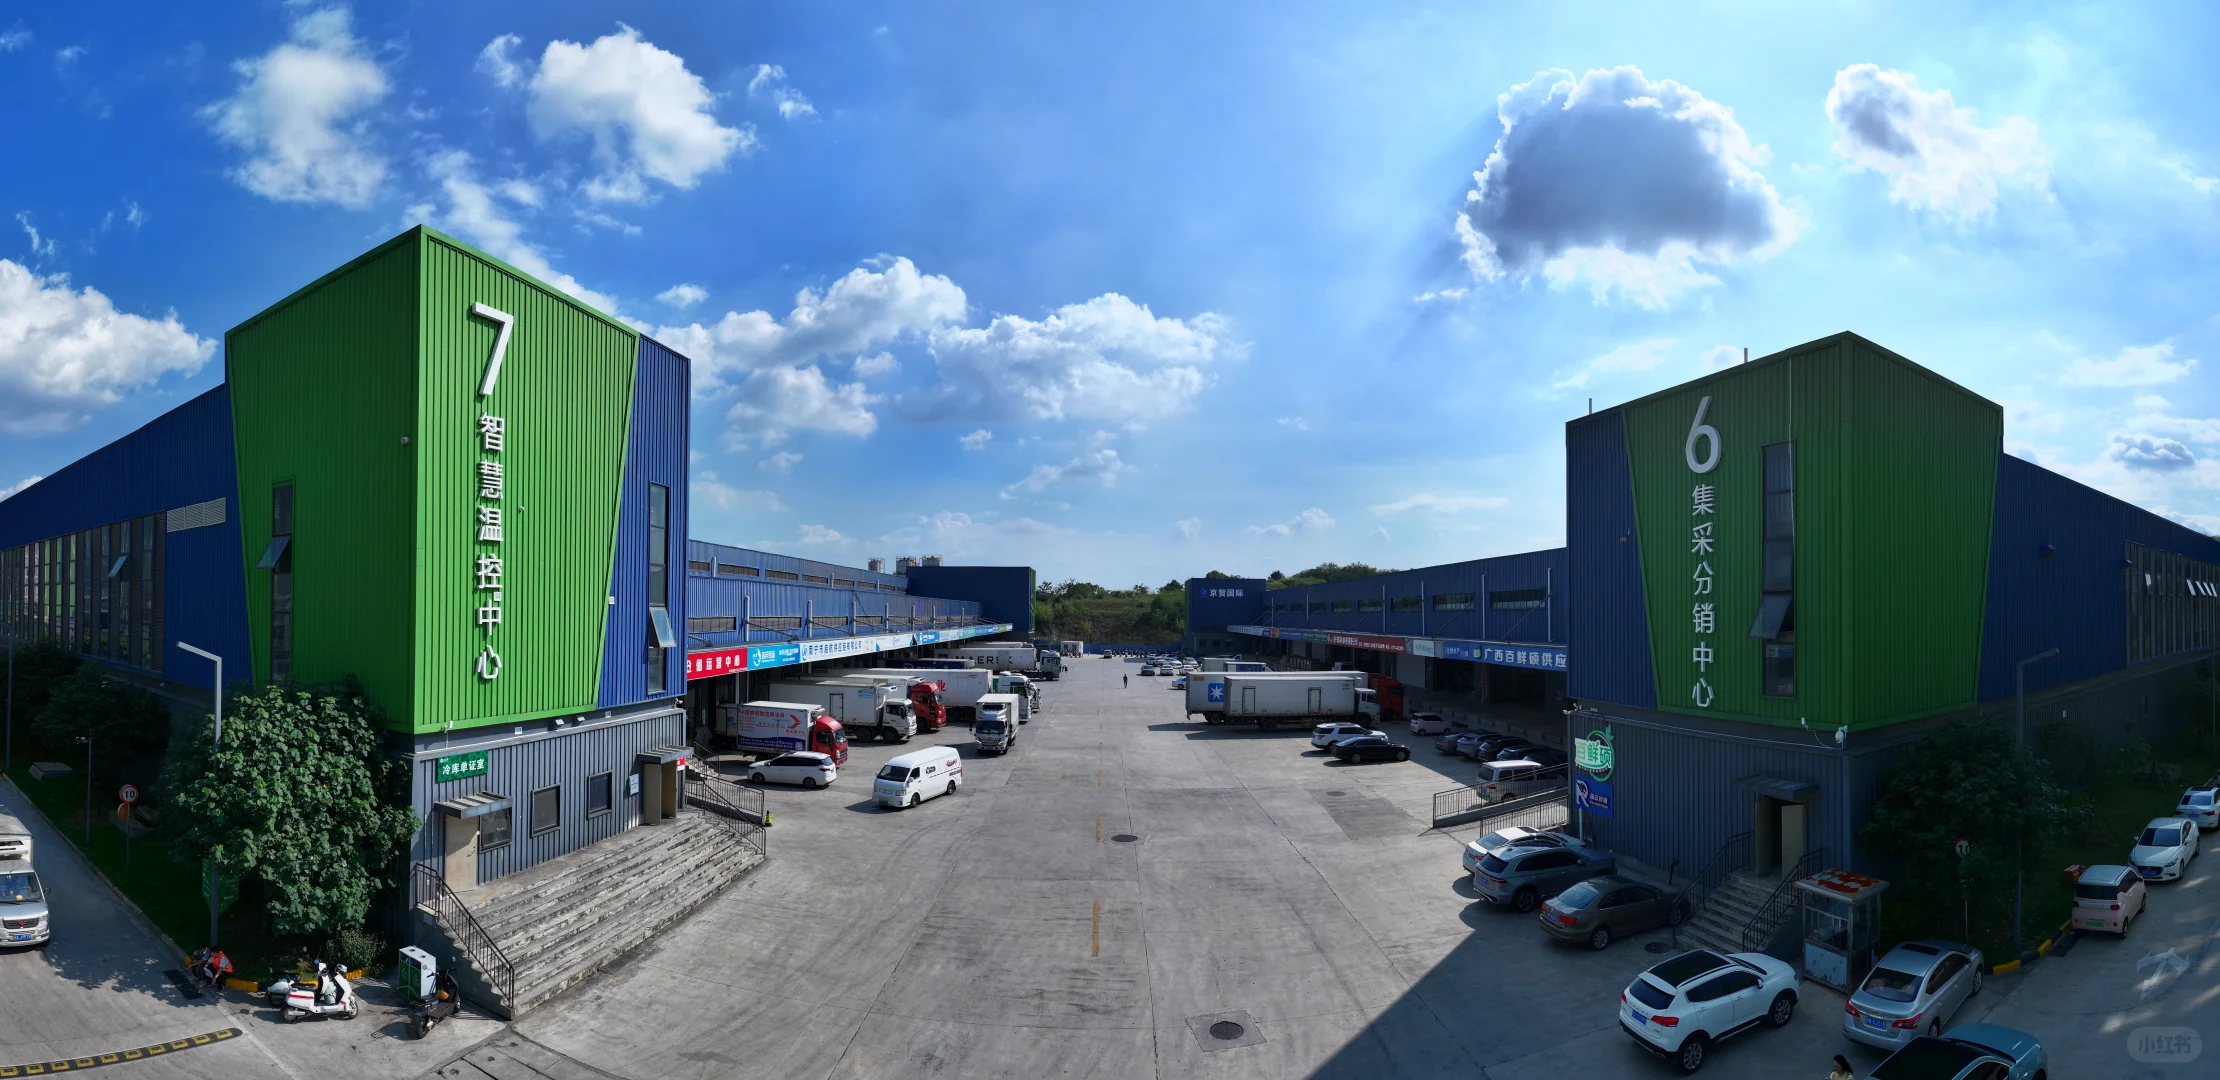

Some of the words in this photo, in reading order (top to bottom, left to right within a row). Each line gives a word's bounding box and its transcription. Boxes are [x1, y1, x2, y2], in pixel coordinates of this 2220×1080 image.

[472, 302, 514, 397] 7
[1685, 395, 1722, 474] 6
[476, 412, 505, 680] 智慧温控中心
[1209, 588, 1244, 598] 京贸国际
[1691, 484, 1716, 708] 集采分销中心
[1484, 648, 1567, 668] 广西百鲜硕供应
[442, 758, 485, 776] 冷库单证室
[1575, 739, 1612, 768] 百鲜硕
[124, 790, 136, 799] 10
